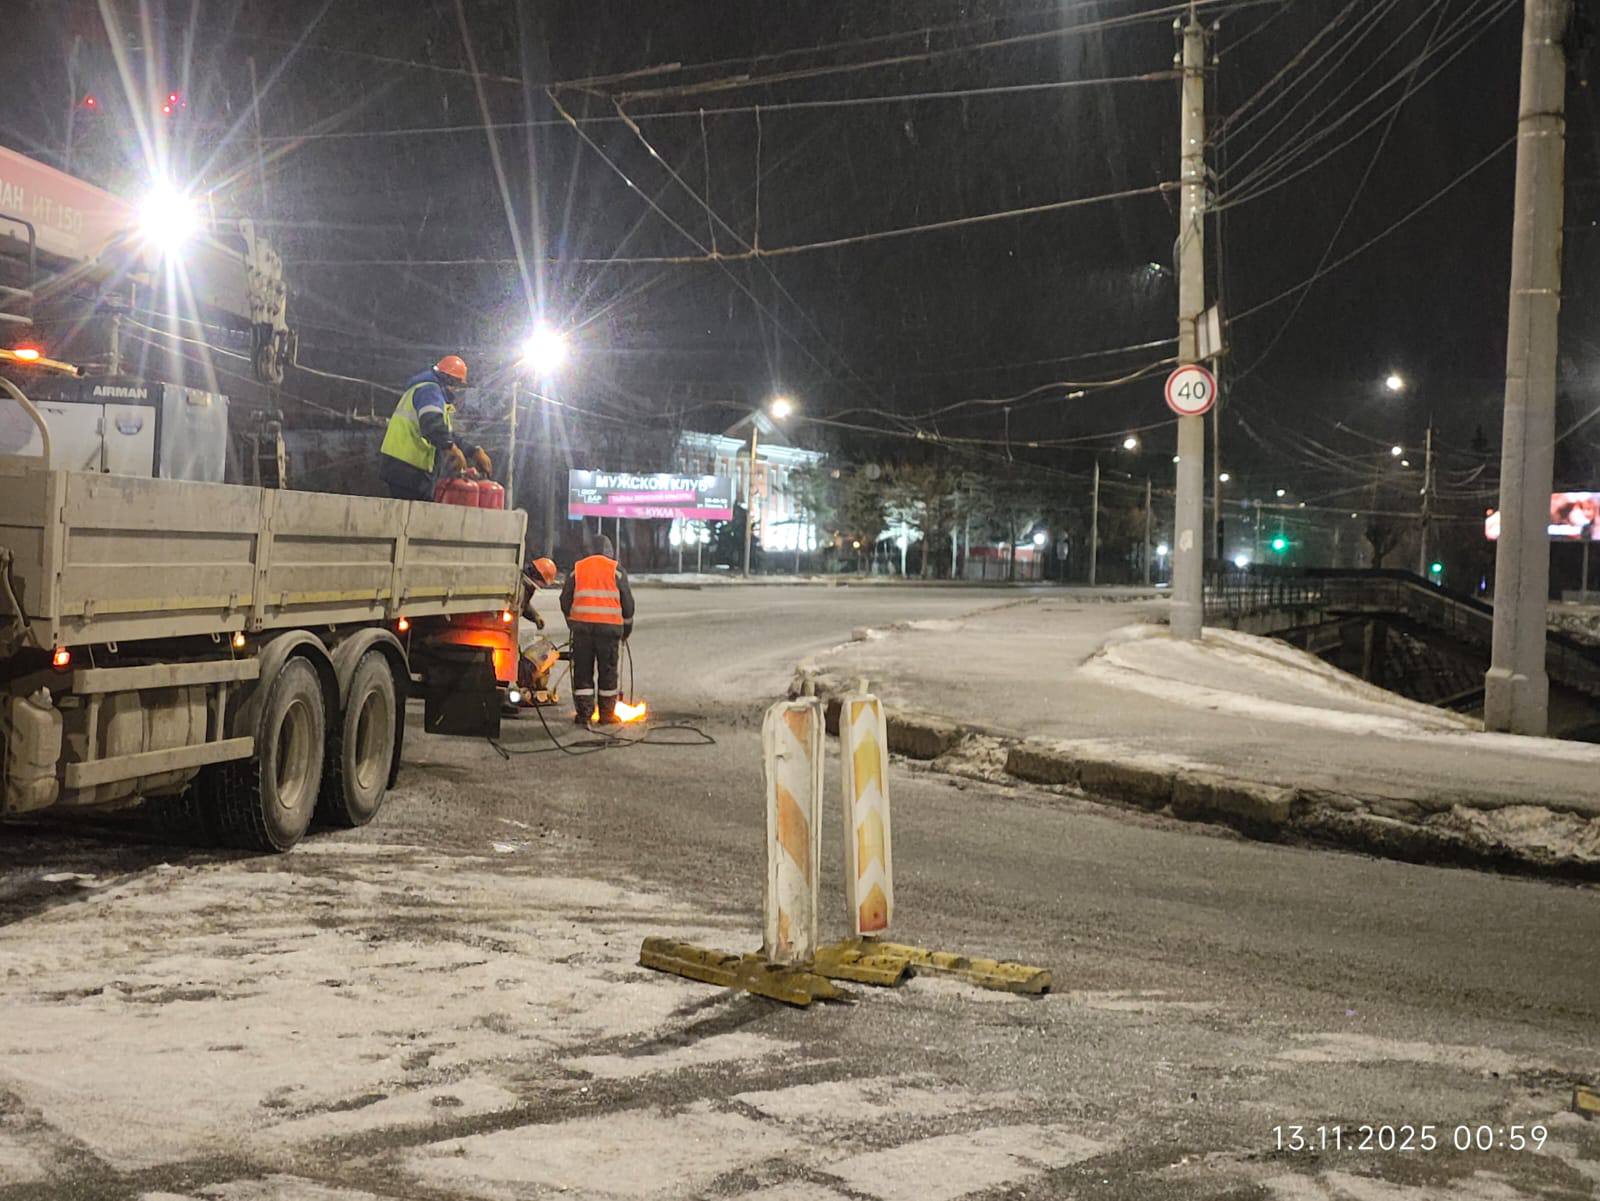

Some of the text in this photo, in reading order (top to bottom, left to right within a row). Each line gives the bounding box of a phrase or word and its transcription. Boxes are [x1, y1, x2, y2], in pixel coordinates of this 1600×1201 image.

[0, 178, 24, 212] АН
[57, 202, 82, 234] 150
[93, 385, 148, 398] AIRMAN
[1178, 381, 1206, 400] 40
[595, 475, 668, 491] МУЖСКОЙ
